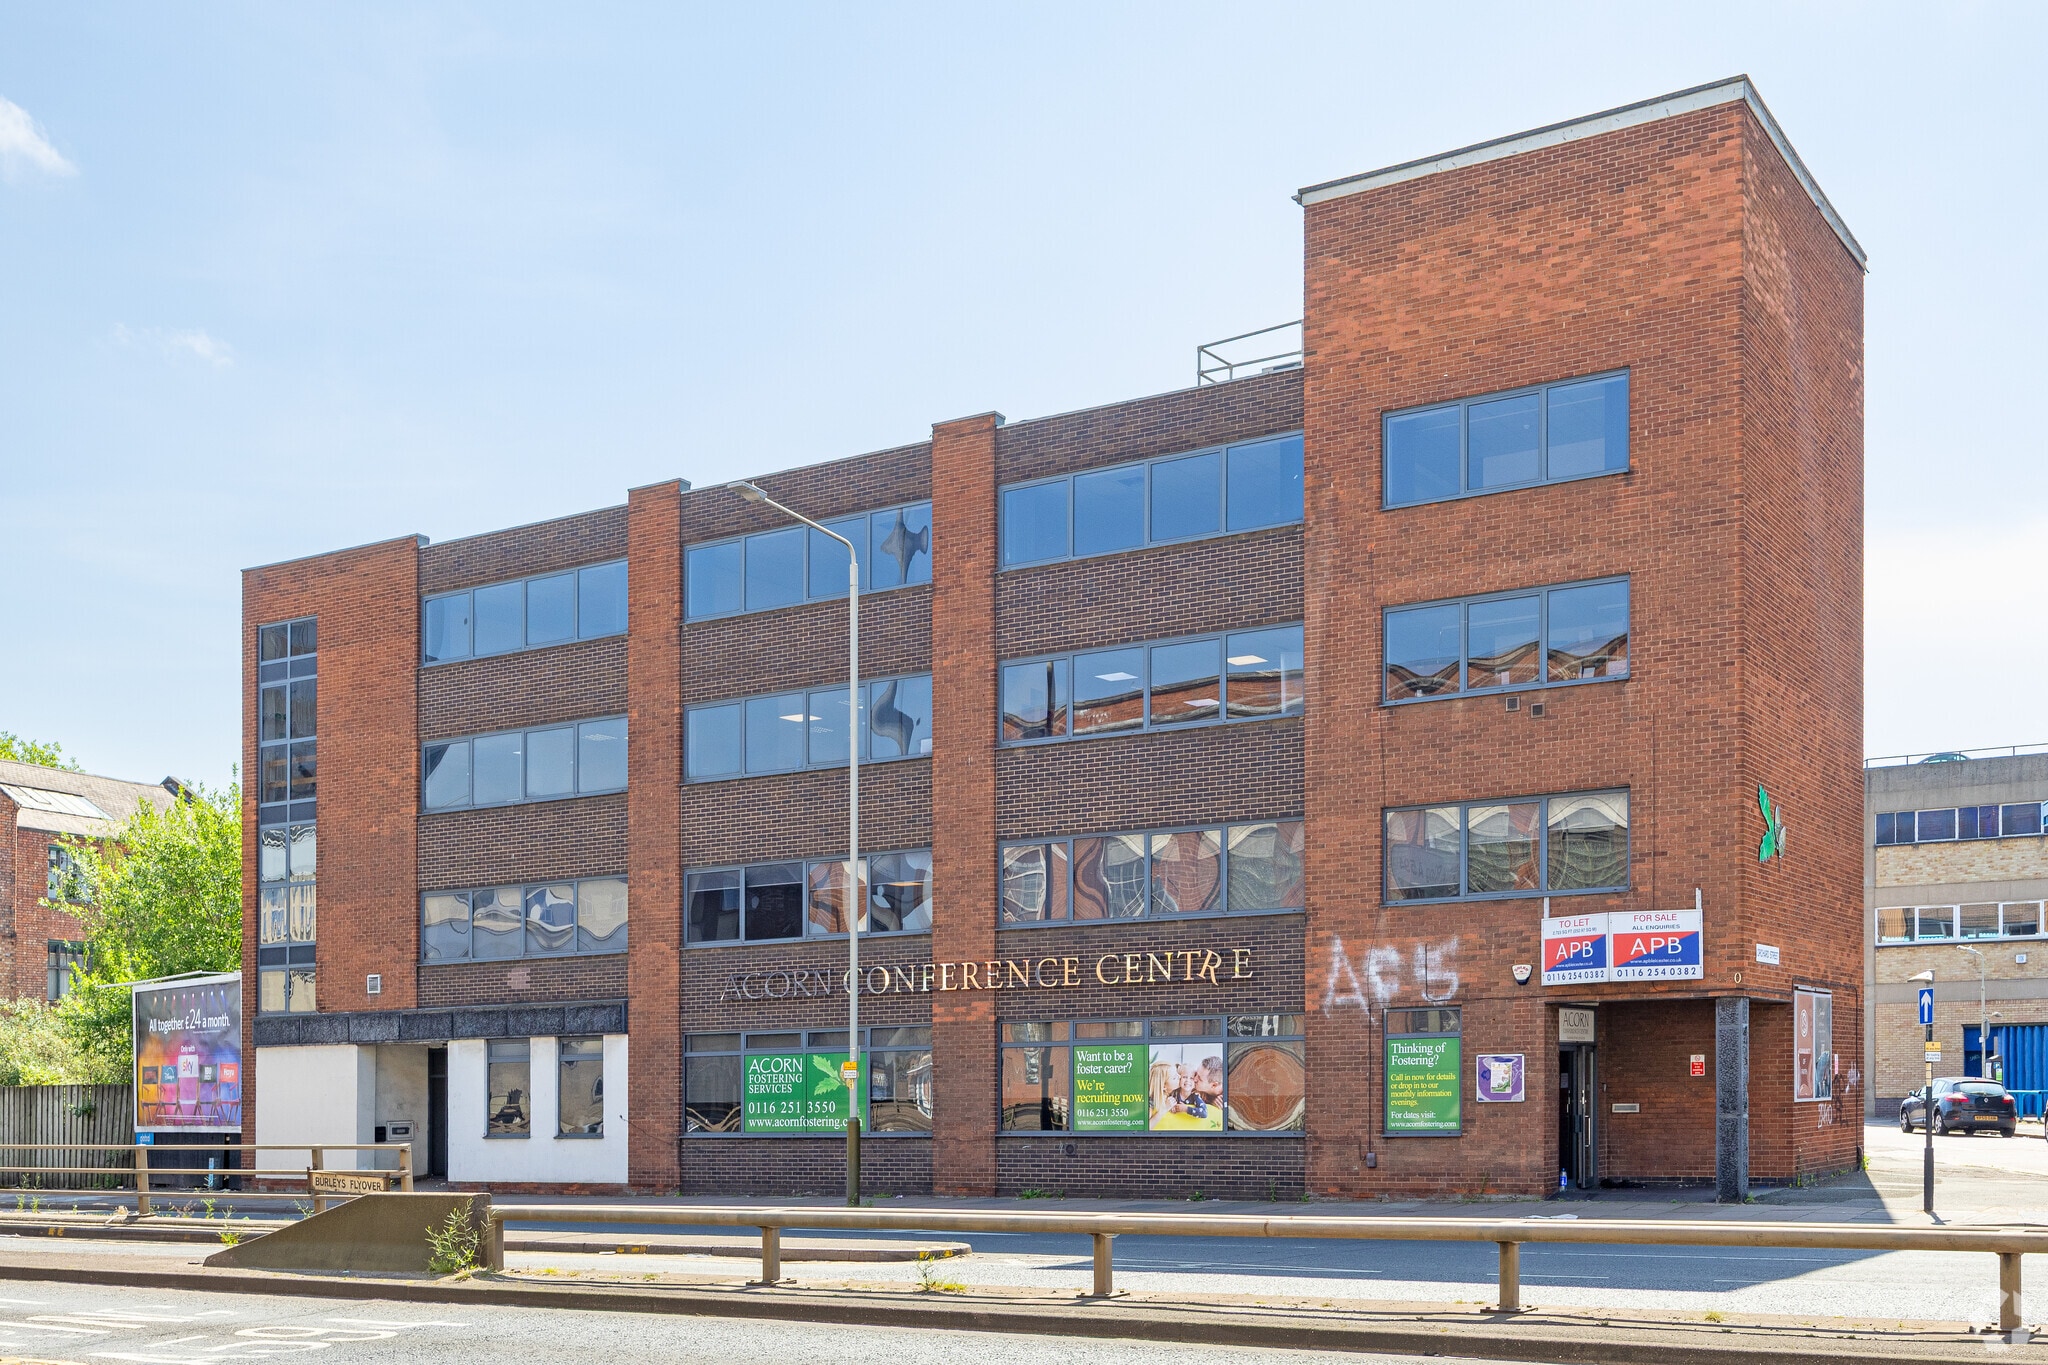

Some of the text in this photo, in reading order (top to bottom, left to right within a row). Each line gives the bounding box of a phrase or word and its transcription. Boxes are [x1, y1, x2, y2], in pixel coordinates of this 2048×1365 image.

[1559, 918, 1590, 928] TO LET
[1634, 914, 1652, 922] FOR
[1556, 941, 1594, 960] APB
[1630, 937, 1682, 955] APB
[720, 948, 1253, 1000] ACORN CONFERENCE CENTRE
[1547, 970, 1604, 981] 0116 254 0382
[1617, 967, 1696, 977] 0116 254 0382
[149, 1009, 230, 1034] All together. £24 a month.
[1563, 1012, 1589, 1027] ACORN
[1391, 1042, 1446, 1055] Thinking of
[1077, 1051, 1101, 1061] Want
[1103, 1052, 1112, 1061] to
[1114, 1050, 1125, 1061] be
[1391, 1054, 1439, 1067] Fostering?
[182, 1058, 193, 1074] sky
[749, 1058, 802, 1073] ACORN
[1077, 1062, 1132, 1074] foster carer?
[749, 1074, 802, 1083] FOSTERING
[749, 1084, 792, 1094] SERVICES
[1398, 1082, 1412, 1090] drop
[1077, 1092, 1144, 1105] recruiting now.
[1391, 1090, 1416, 1098] monthly
[749, 1101, 836, 1114] 0116 251 3550
[1391, 1099, 1418, 1107] evenings.
[1077, 1108, 1128, 1117] 0116 251 3550
[1391, 1111, 1402, 1119] For
[749, 1116, 862, 1129] www.acornfostering.c
[316, 1177, 381, 1191] BURLEYS FLYOVER
